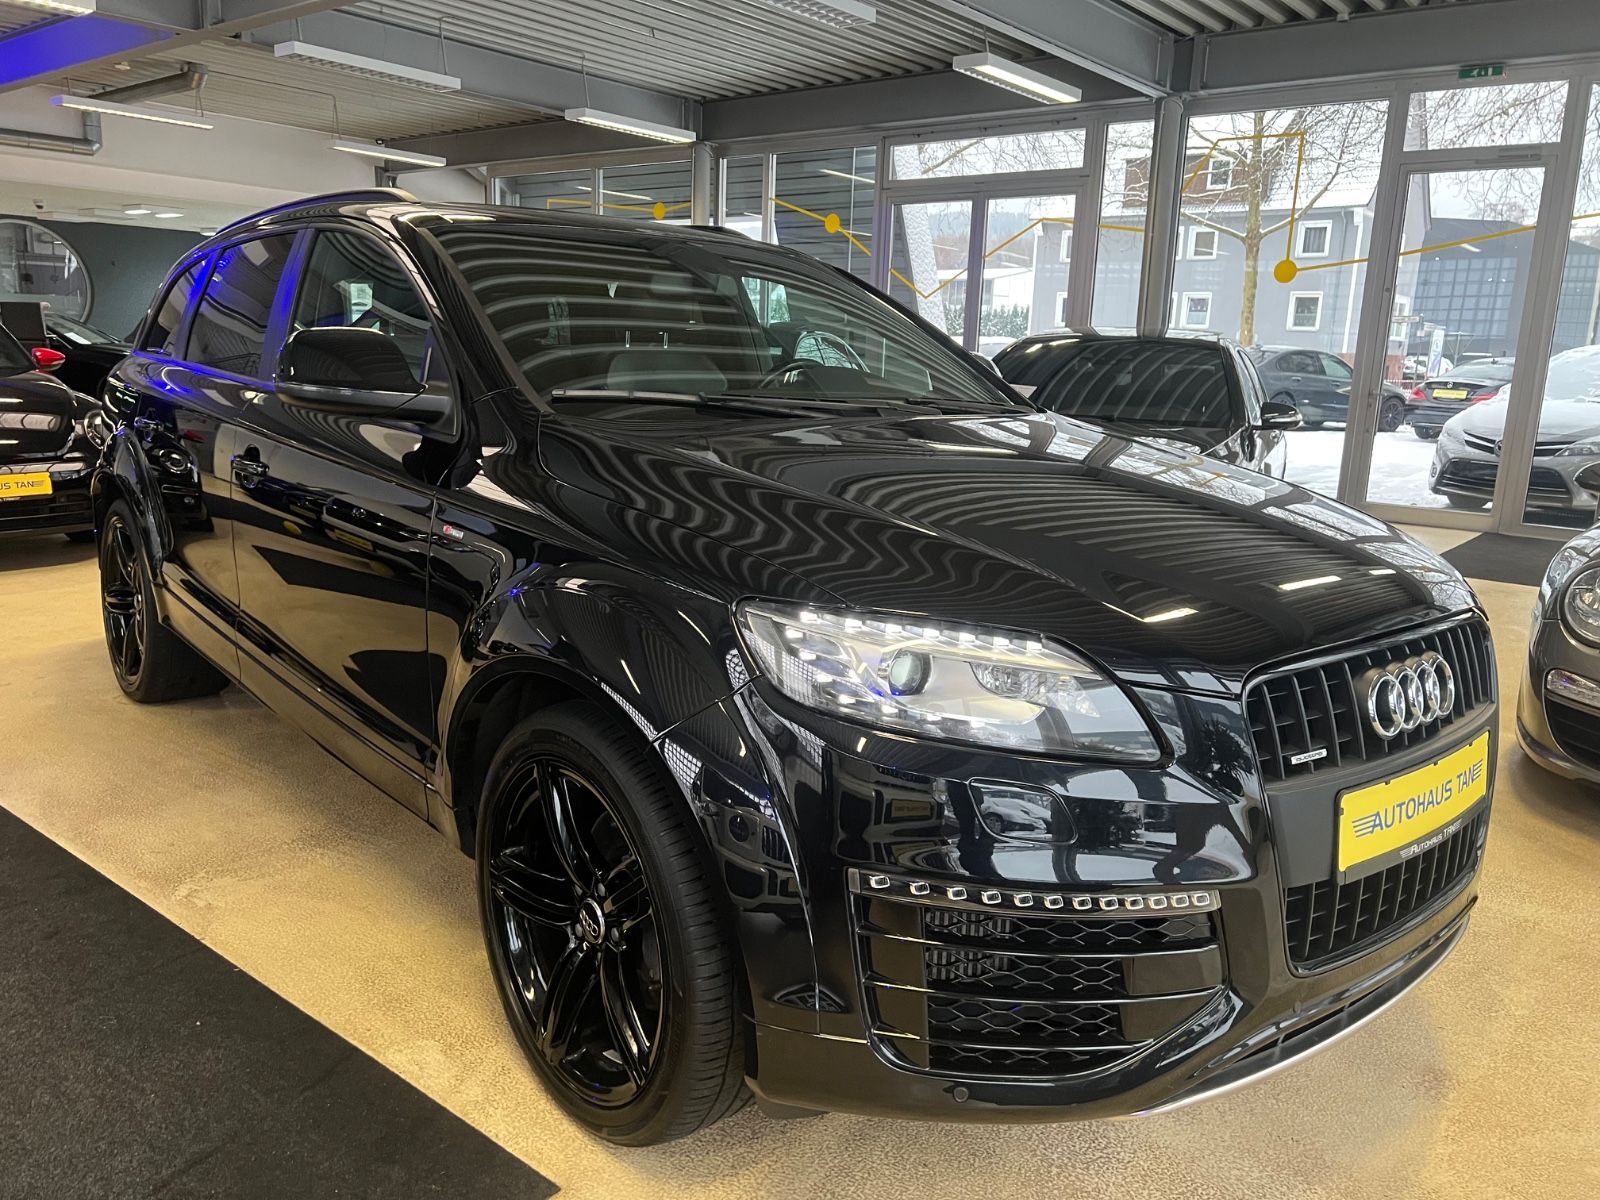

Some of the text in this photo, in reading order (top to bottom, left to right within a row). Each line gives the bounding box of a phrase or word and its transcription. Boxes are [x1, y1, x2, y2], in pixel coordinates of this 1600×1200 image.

[14, 480, 34, 489] TAN
[1370, 765, 1475, 834] AUTOHAUS TAN
